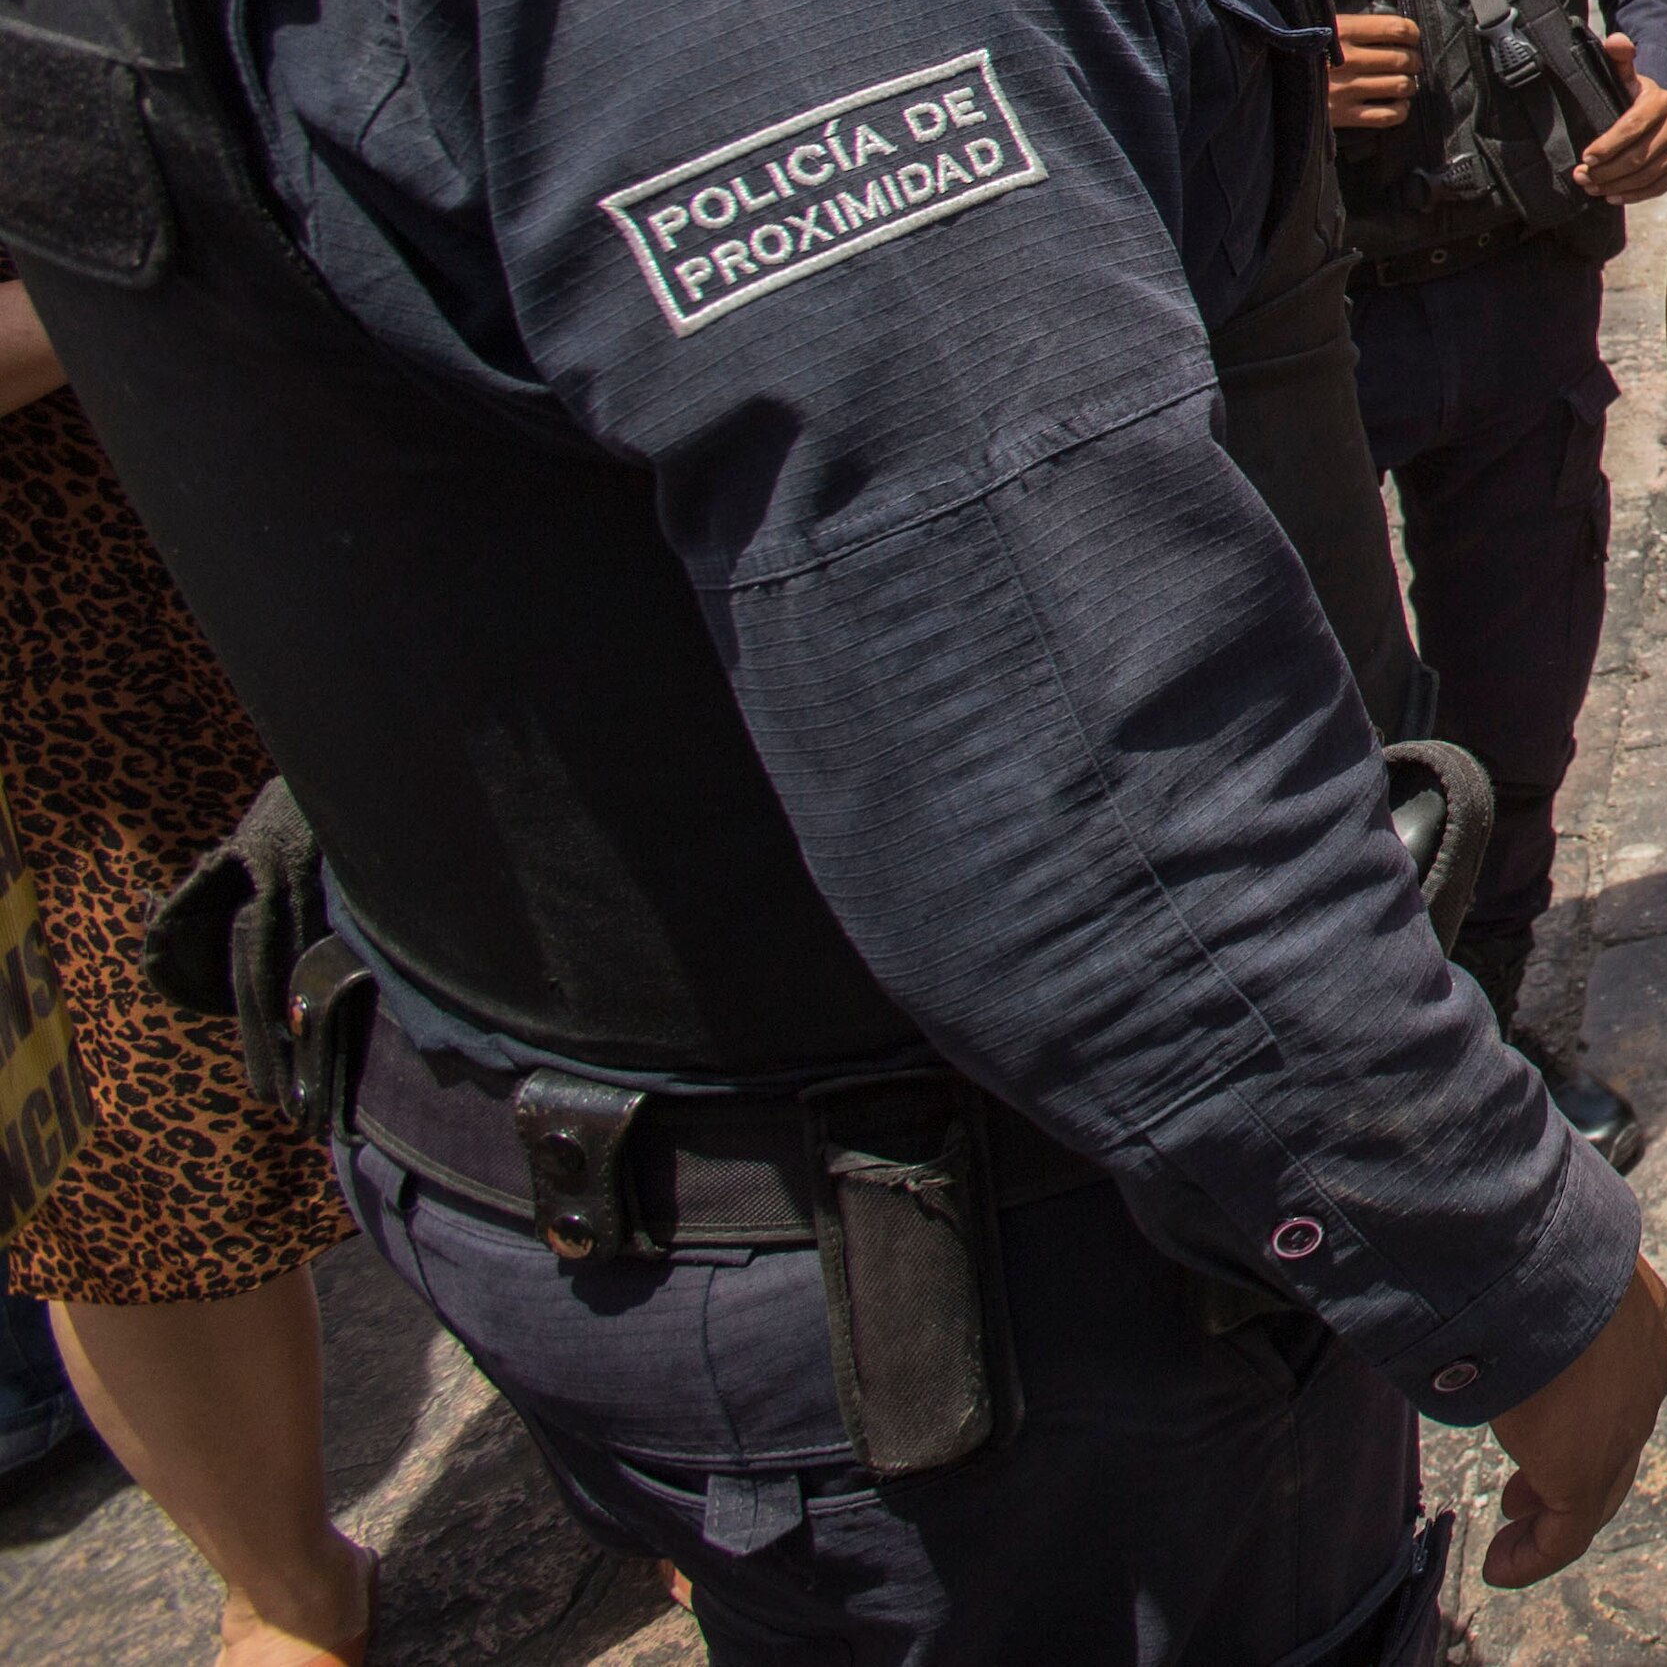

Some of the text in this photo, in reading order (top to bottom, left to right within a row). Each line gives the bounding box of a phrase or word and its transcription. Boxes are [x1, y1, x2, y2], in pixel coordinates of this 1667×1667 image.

[648, 86, 988, 252] POLICÍA DE
[674, 137, 1004, 303] PROXIMIDAD
